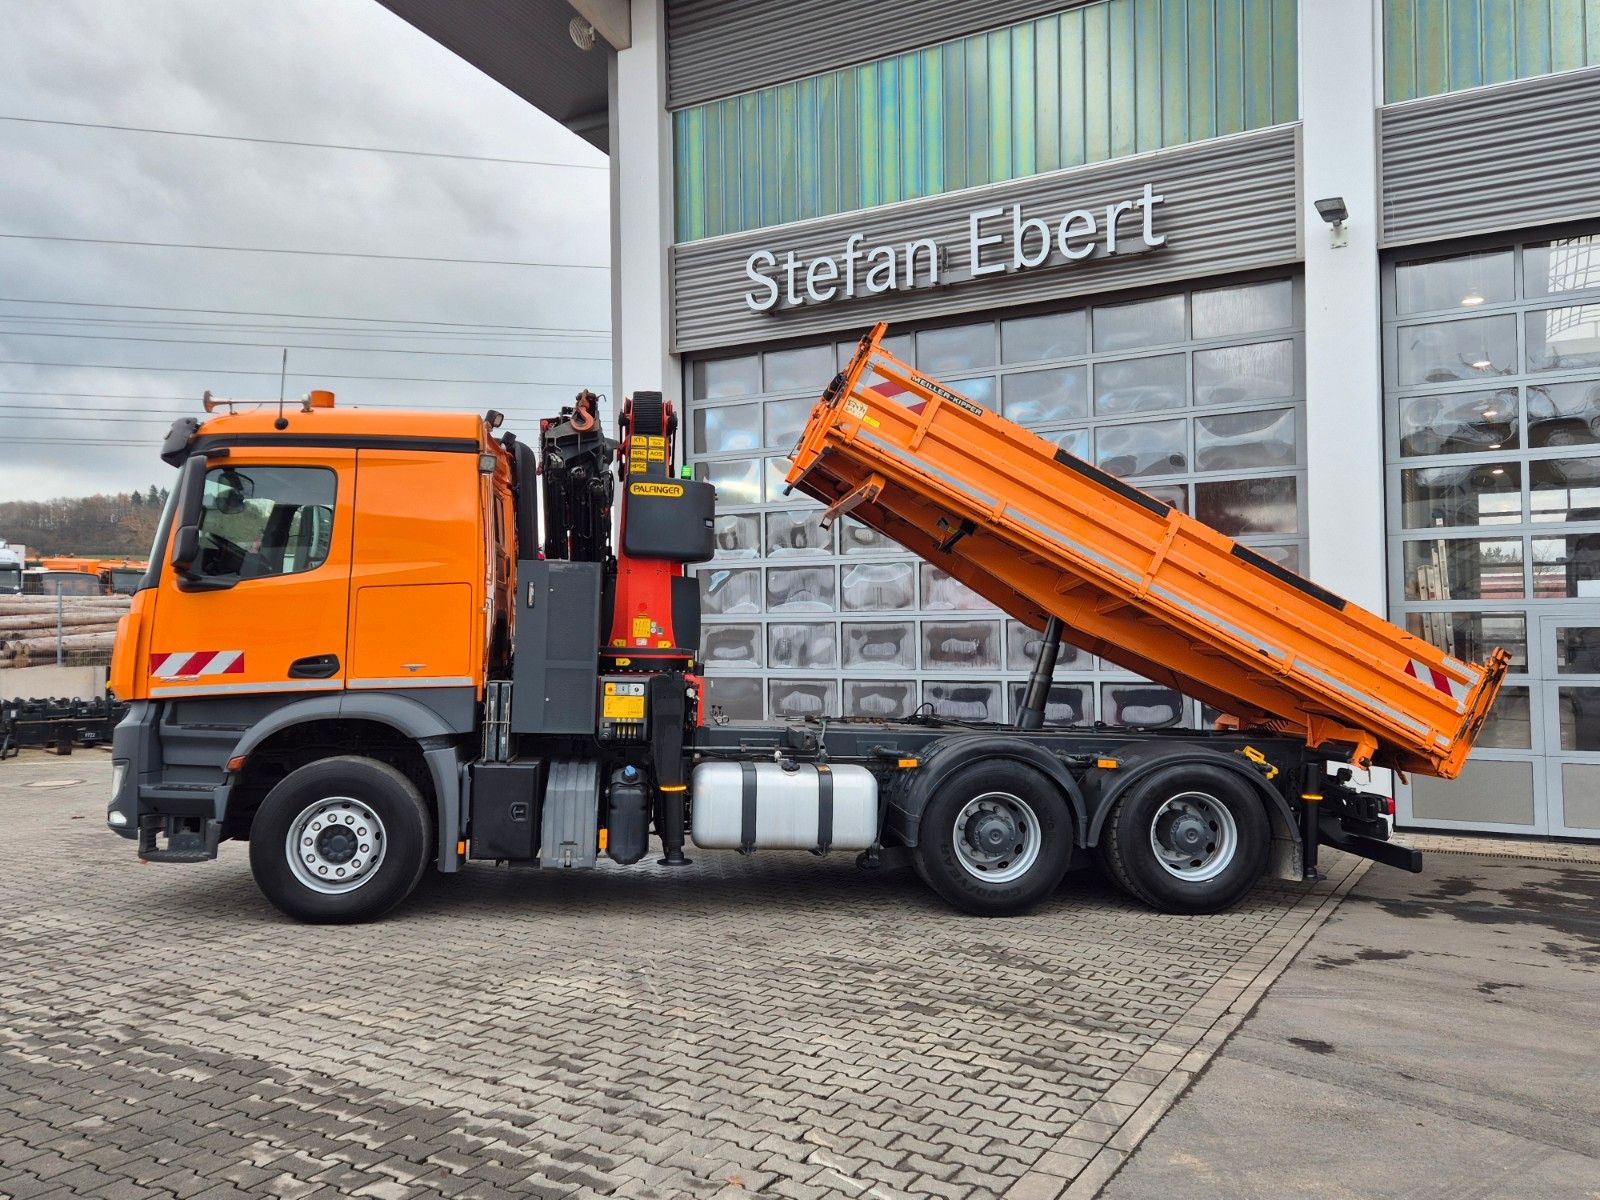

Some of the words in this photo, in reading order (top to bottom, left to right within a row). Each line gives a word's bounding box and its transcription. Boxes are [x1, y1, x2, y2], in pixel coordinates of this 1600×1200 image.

[745, 233, 939, 311] Stefan
[970, 183, 1166, 276] Ebert
[911, 376, 983, 416] MEILLER-KIPPER
[633, 485, 680, 495] PALFINGER
